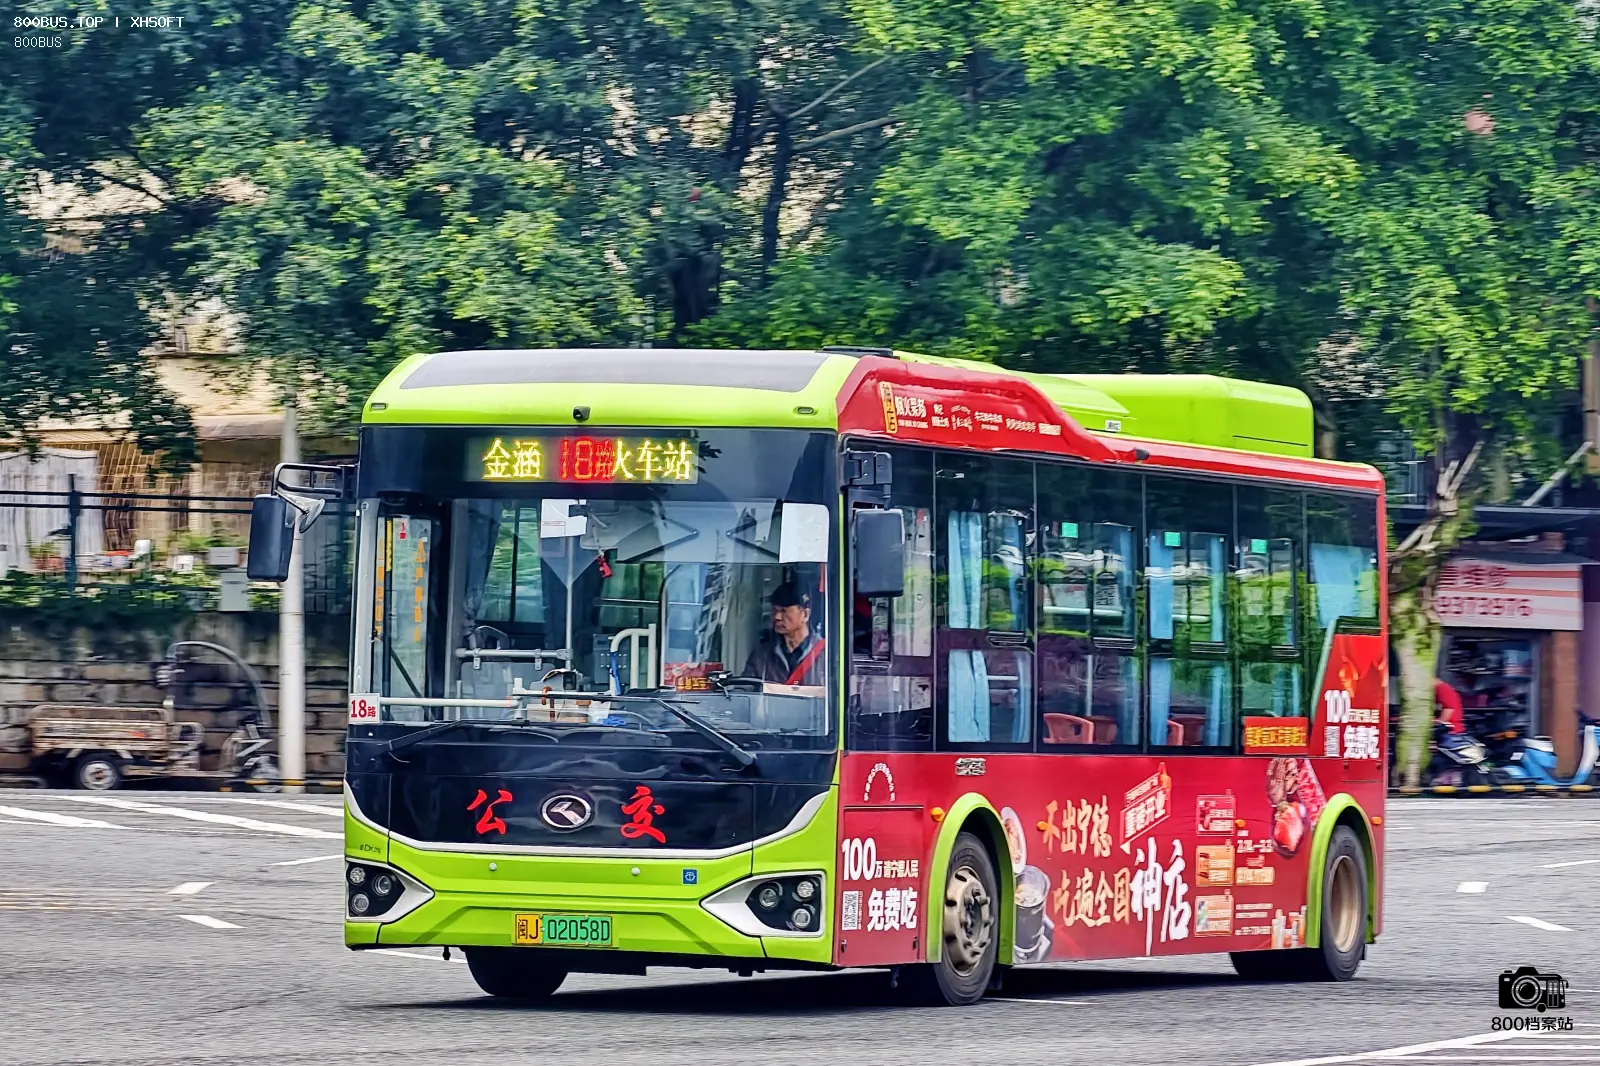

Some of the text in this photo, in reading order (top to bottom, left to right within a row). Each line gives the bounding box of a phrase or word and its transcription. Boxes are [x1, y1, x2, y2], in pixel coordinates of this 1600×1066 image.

[482, 437, 542, 479] 金涵
[612, 438, 693, 480] 火车站
[351, 699, 376, 718] 18路
[466, 786, 666, 844] 公 交
[1042, 795, 1112, 857] 不出宁德
[867, 886, 918, 932] 免费吃
[1130, 836, 1192, 957] 神店
